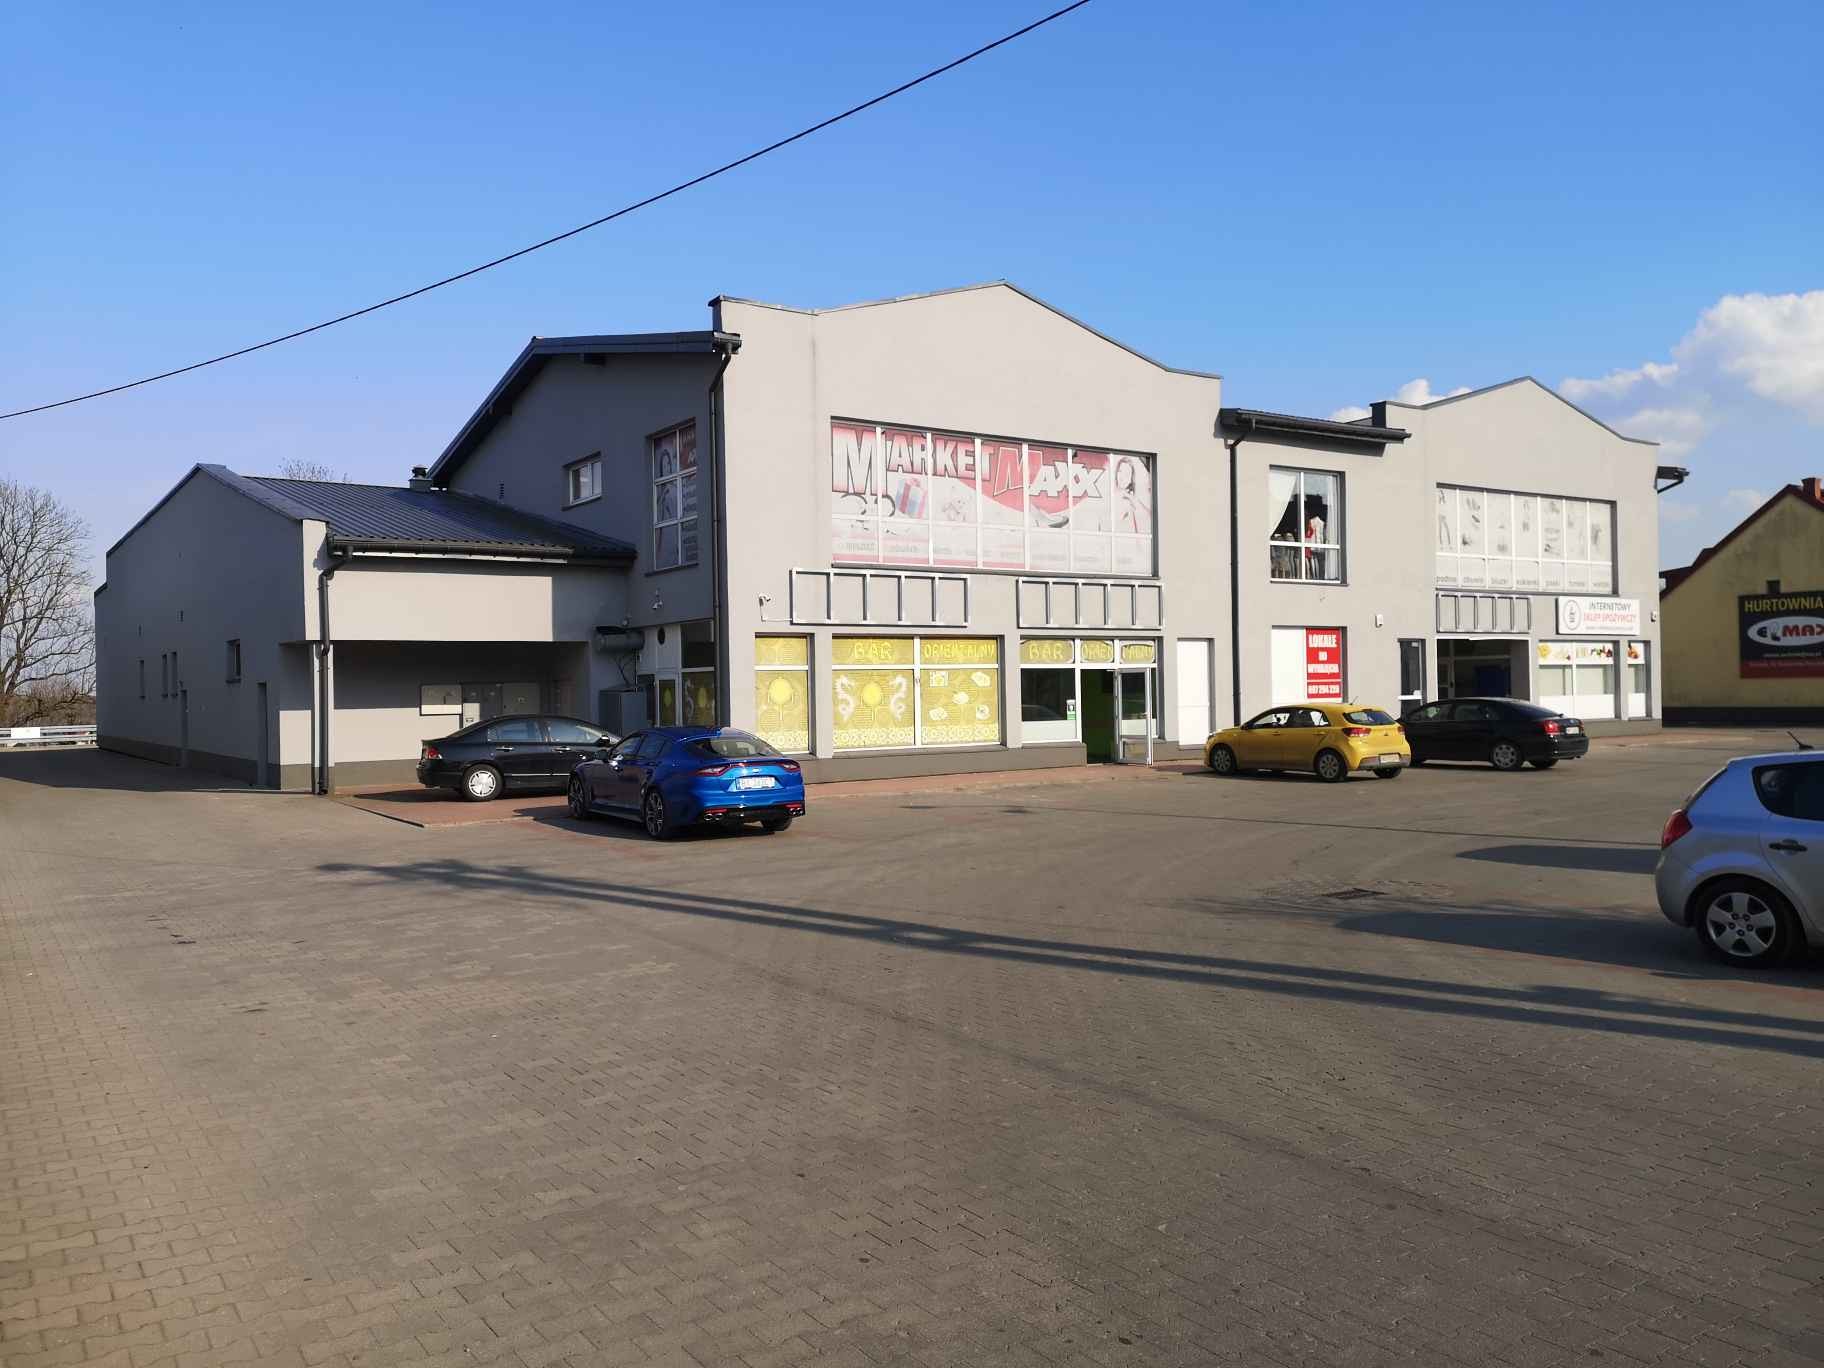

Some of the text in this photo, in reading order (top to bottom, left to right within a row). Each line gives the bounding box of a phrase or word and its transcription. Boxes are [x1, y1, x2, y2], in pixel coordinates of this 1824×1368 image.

[832, 427, 1103, 498] MARKET MAXX
[1588, 601, 1631, 611] INTERNETOWY
[1744, 596, 1824, 612] HURTOWNIA
[1308, 634, 1338, 648] LOKALE
[854, 641, 892, 659] BAR
[1029, 643, 1063, 660] BAR
